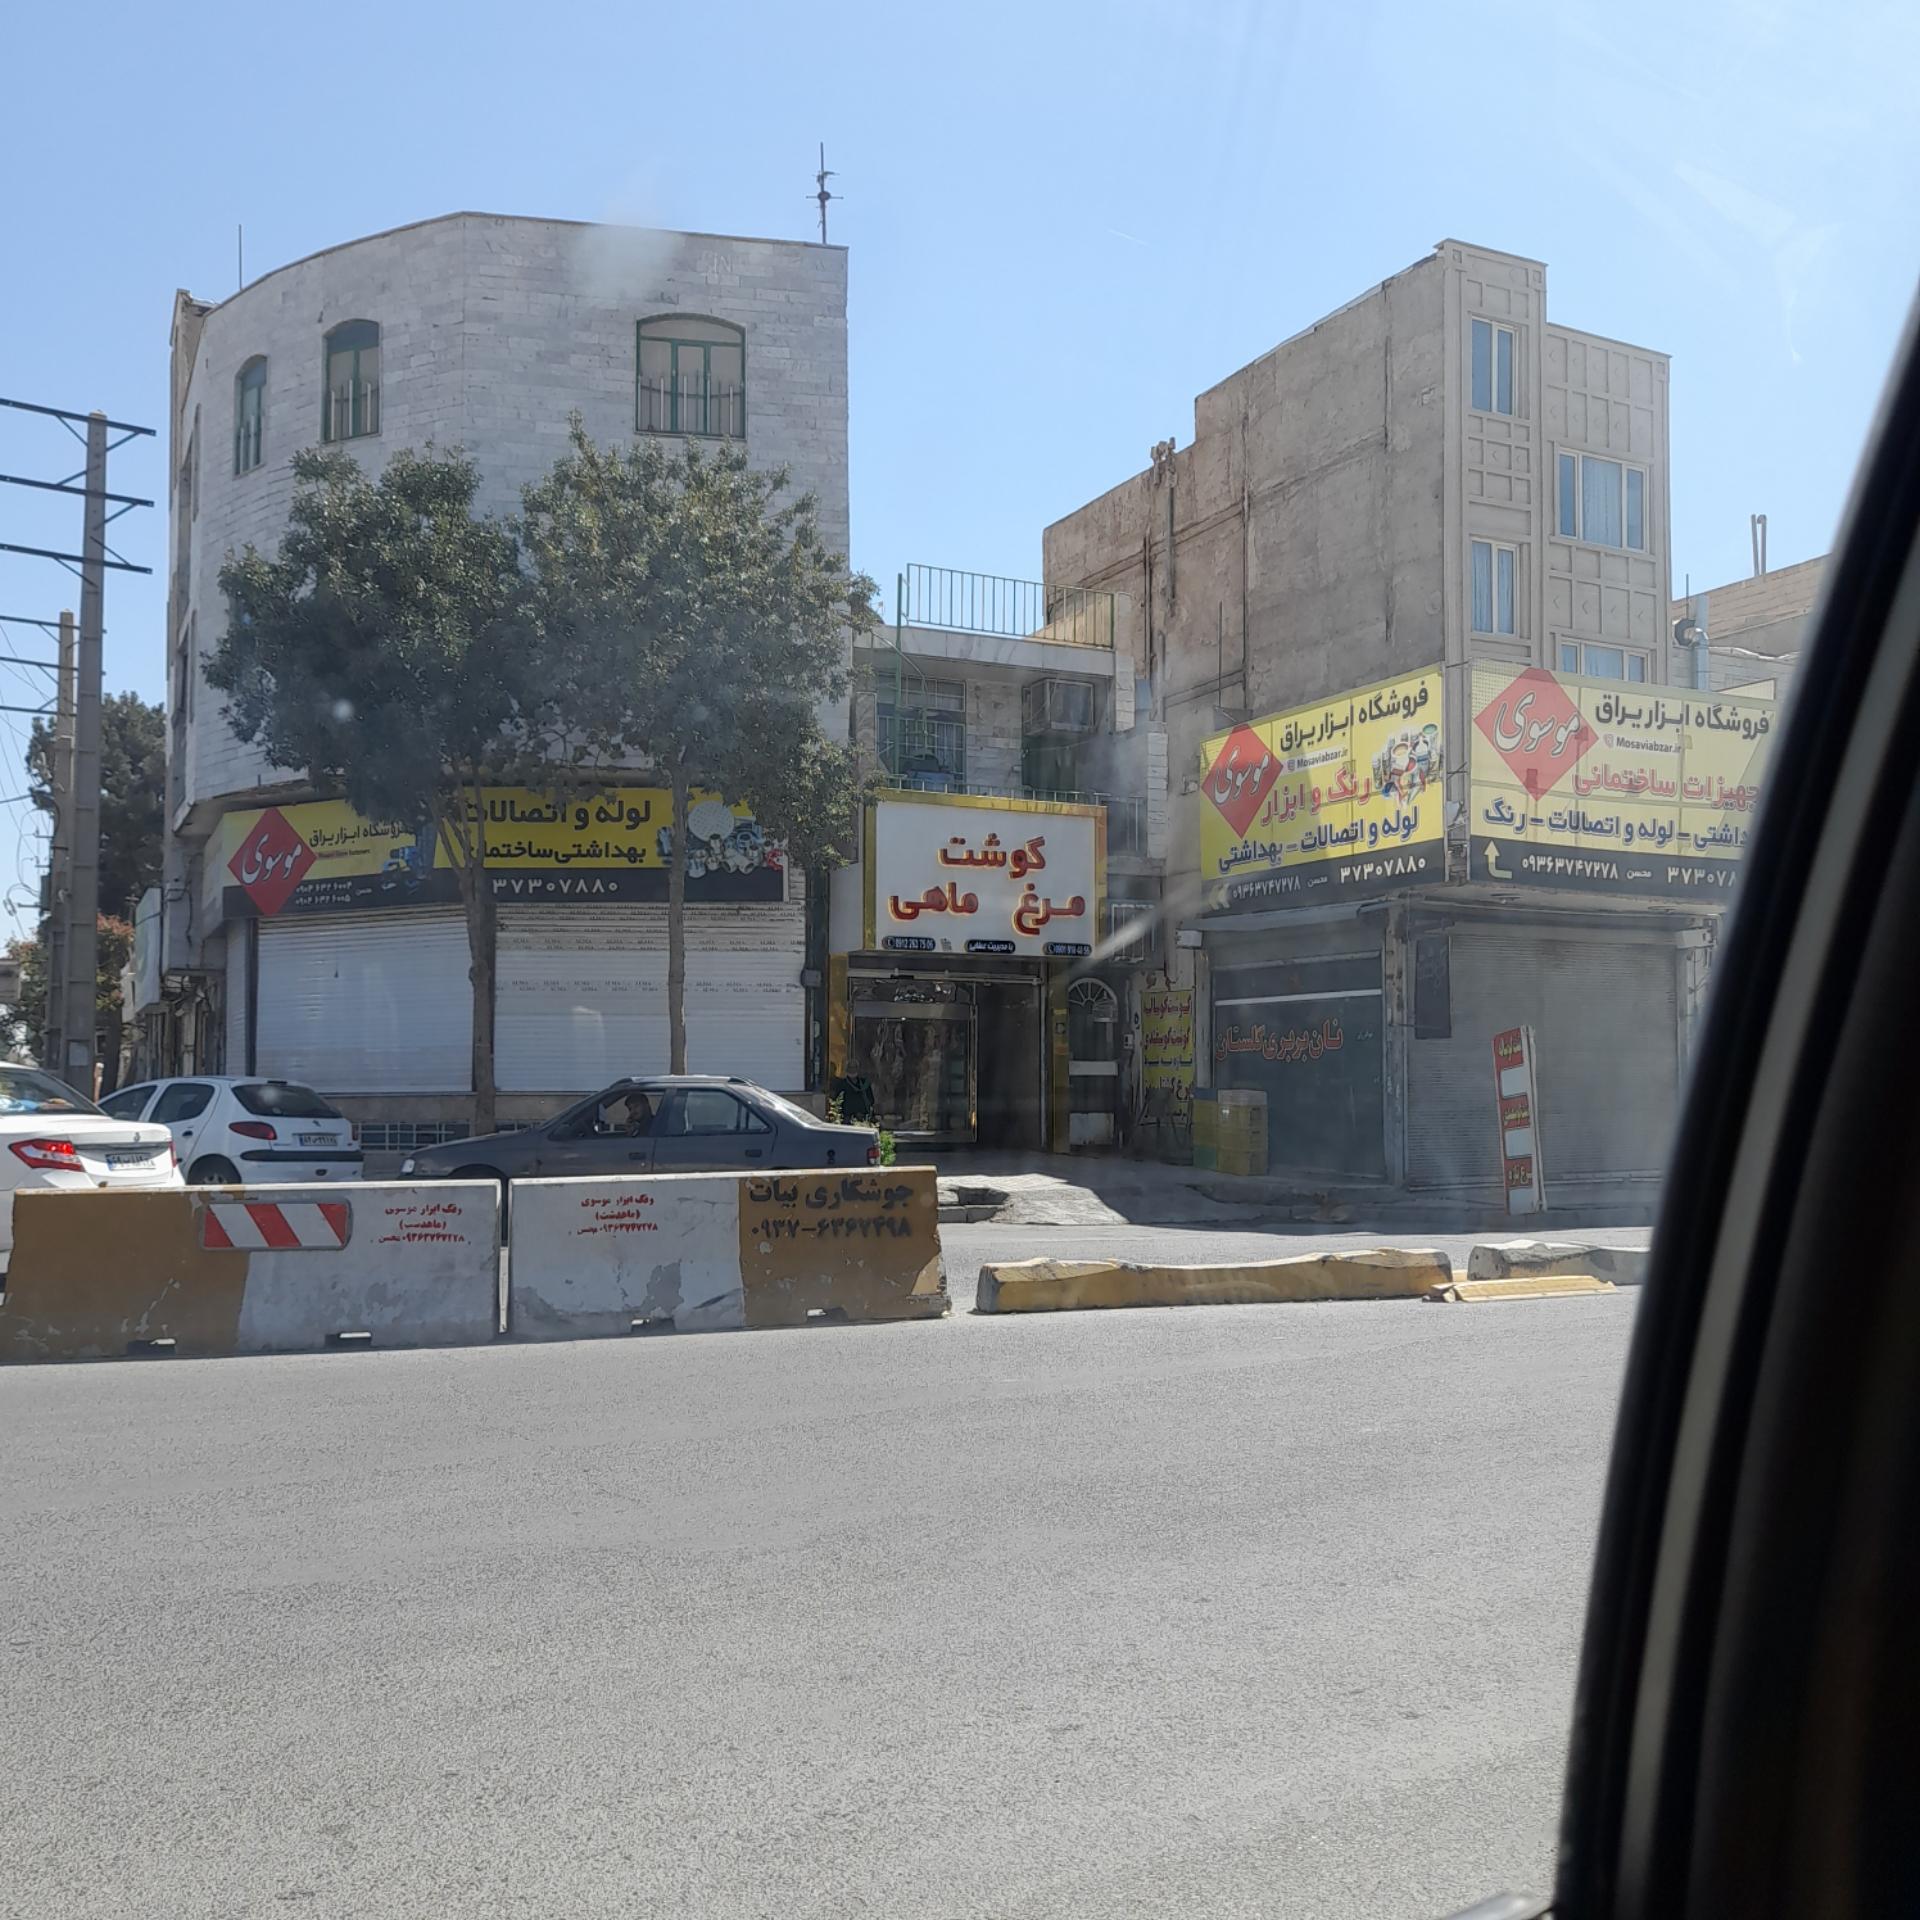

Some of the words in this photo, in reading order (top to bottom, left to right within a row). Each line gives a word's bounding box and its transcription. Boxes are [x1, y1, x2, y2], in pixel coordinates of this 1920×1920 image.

[1358, 680, 1428, 723] فروشگاه
[1595, 694, 1642, 729] یراق
[1648, 700, 1690, 733] ابزار
[1280, 720, 1316, 752] یراق
[1318, 705, 1354, 740] ابزار
[1494, 691, 1581, 757] موسوی
[1695, 703, 1769, 739] فروشگاه
[1213, 745, 1270, 805] موسوی
[1327, 766, 1371, 804] رنگ
[1571, 763, 1677, 798] ساختمانی
[1311, 787, 1322, 814] و
[1681, 773, 1761, 812] جهیزات
[573, 807, 590, 831] و
[595, 800, 651, 831] لوله
[1382, 806, 1419, 841] لوله
[1485, 797, 1527, 832] رنگ
[1547, 809, 1620, 836] اتصالات
[309, 829, 335, 847] یراق
[335, 824, 360, 845] ابزار
[1301, 817, 1364, 852] اتصالات
[1368, 822, 1378, 848] و
[1623, 824, 1634, 842] و
[1637, 818, 1673, 846] لوله
[241, 832, 303, 885] موسوی
[480, 840, 554, 859] ساختما
[554, 838, 647, 864] بهداشتی
[937, 832, 1046, 879] گوشت
[1218, 840, 1284, 874] بهداشتی
[492, 877, 619, 895] ۳۷۳۰۷۸۸۰
[1340, 856, 1426, 883] ۳۷۳۰۷۸۸۰
[1626, 868, 1652, 879] محسن
[888, 881, 980, 920] ماهی
[1011, 882, 1086, 936] مرغ
[1215, 1023, 1265, 1061] گلستان
[1262, 1029, 1310, 1064] بربری
[1308, 1018, 1344, 1059] نان
[750, 1177, 799, 1209] بیات
[805, 1177, 914, 1211] جوشکاری
